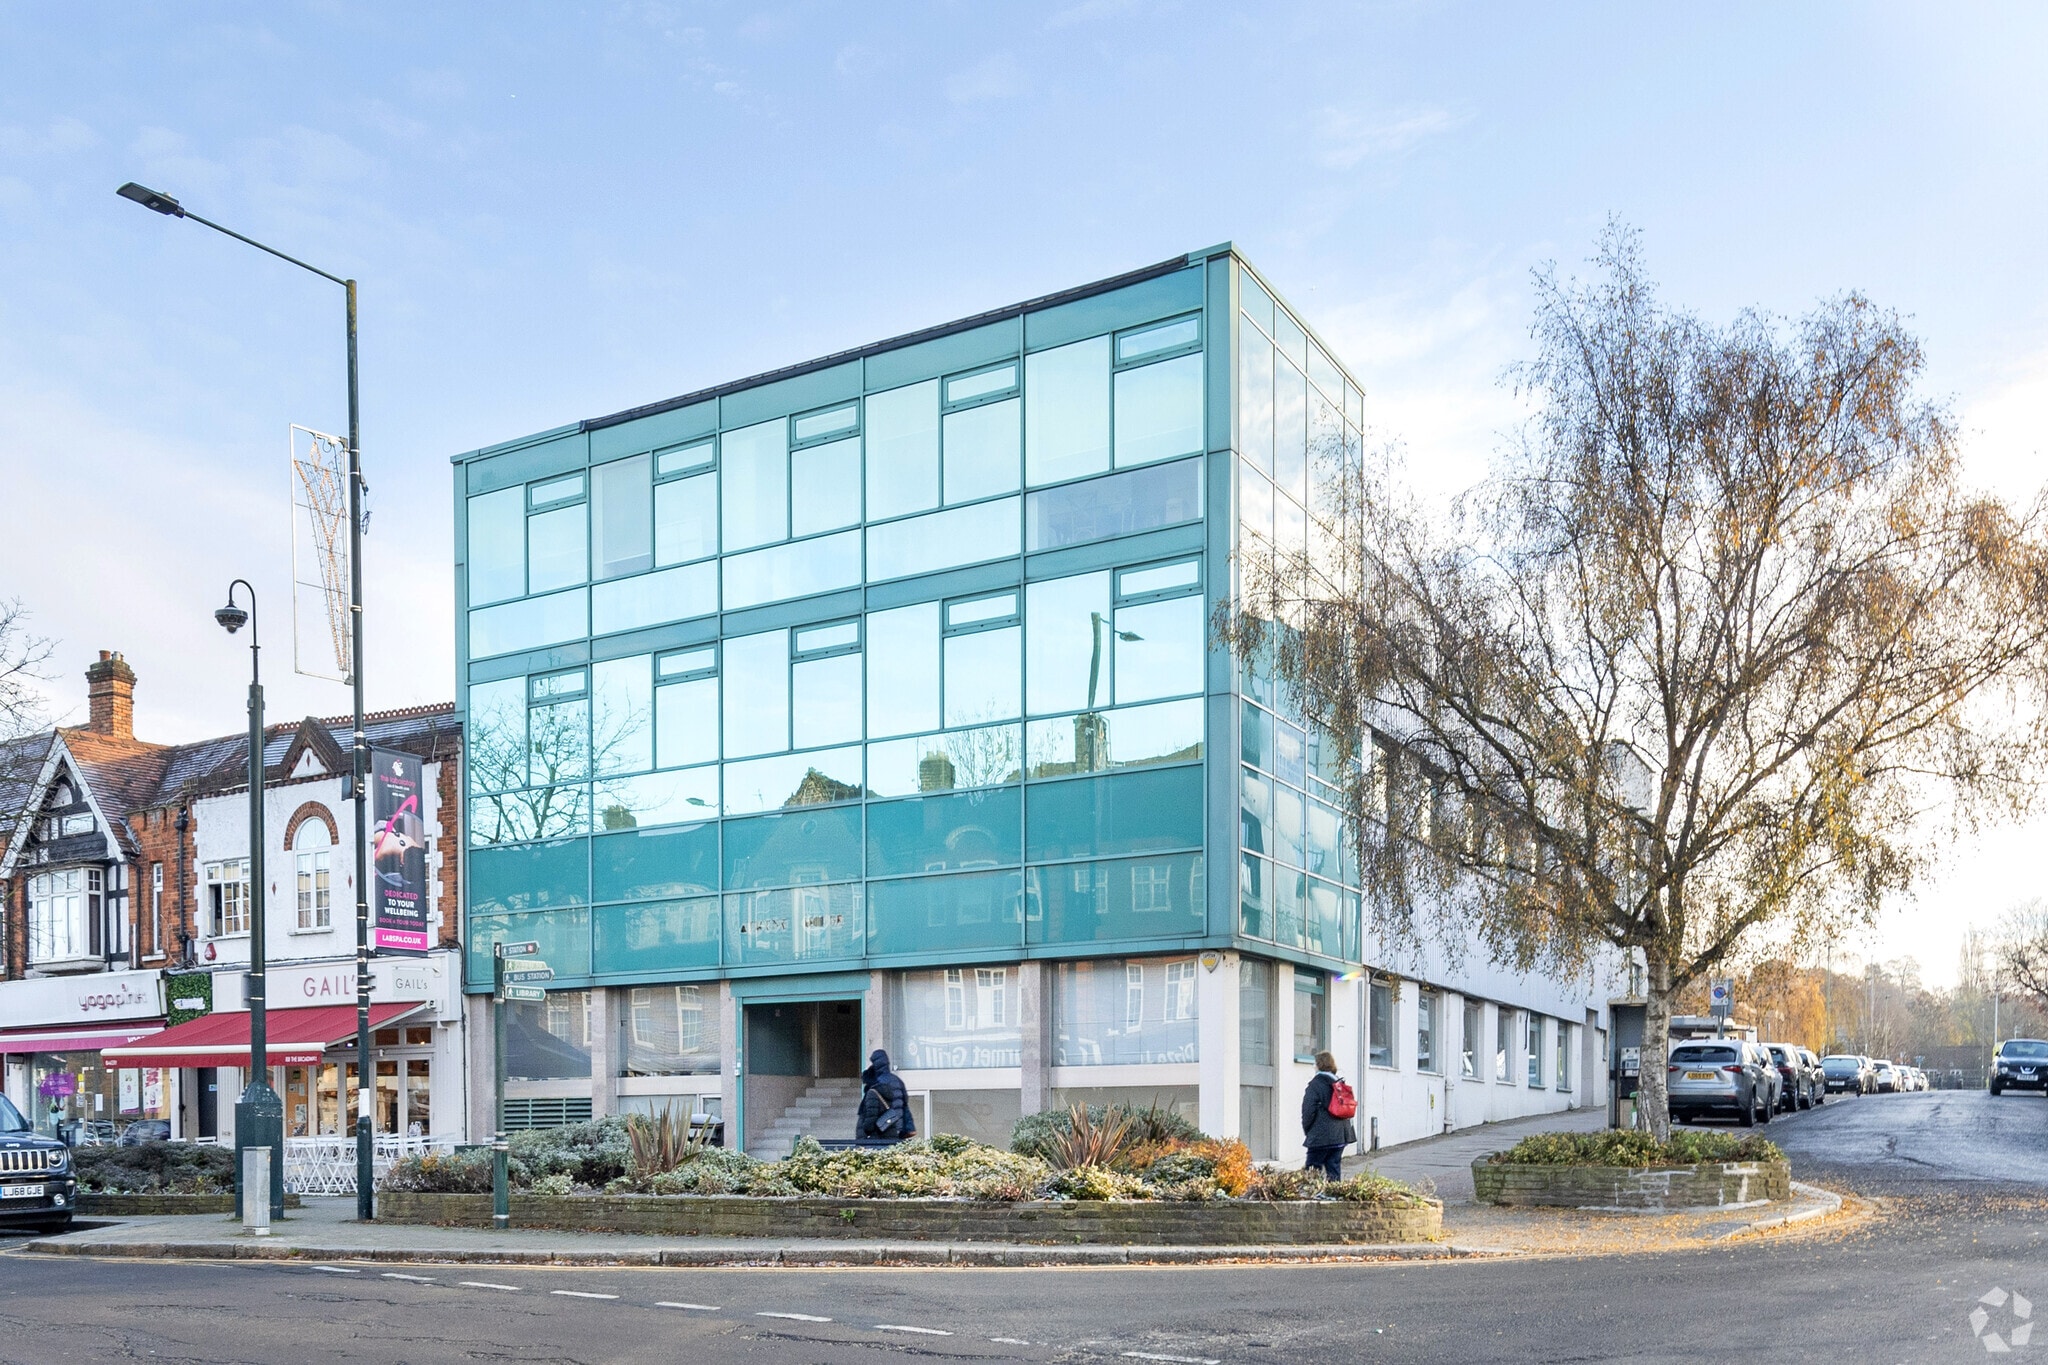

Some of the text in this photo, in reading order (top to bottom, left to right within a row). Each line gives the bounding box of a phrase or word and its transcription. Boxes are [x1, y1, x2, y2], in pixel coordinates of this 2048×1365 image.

[384, 889, 419, 900] DEDICATED
[387, 898, 415, 908] TO YOUR
[384, 906, 419, 917] WELLBEING
[382, 934, 422, 945] LABSPA.CO.UK
[508, 946, 527, 954] STATION
[513, 971, 550, 981] BUS STATION
[303, 974, 356, 998] GAIL'
[395, 978, 428, 990] GAIL's
[516, 990, 541, 998] LIBRARY
[3, 1186, 43, 1197] LJ68 GJE
